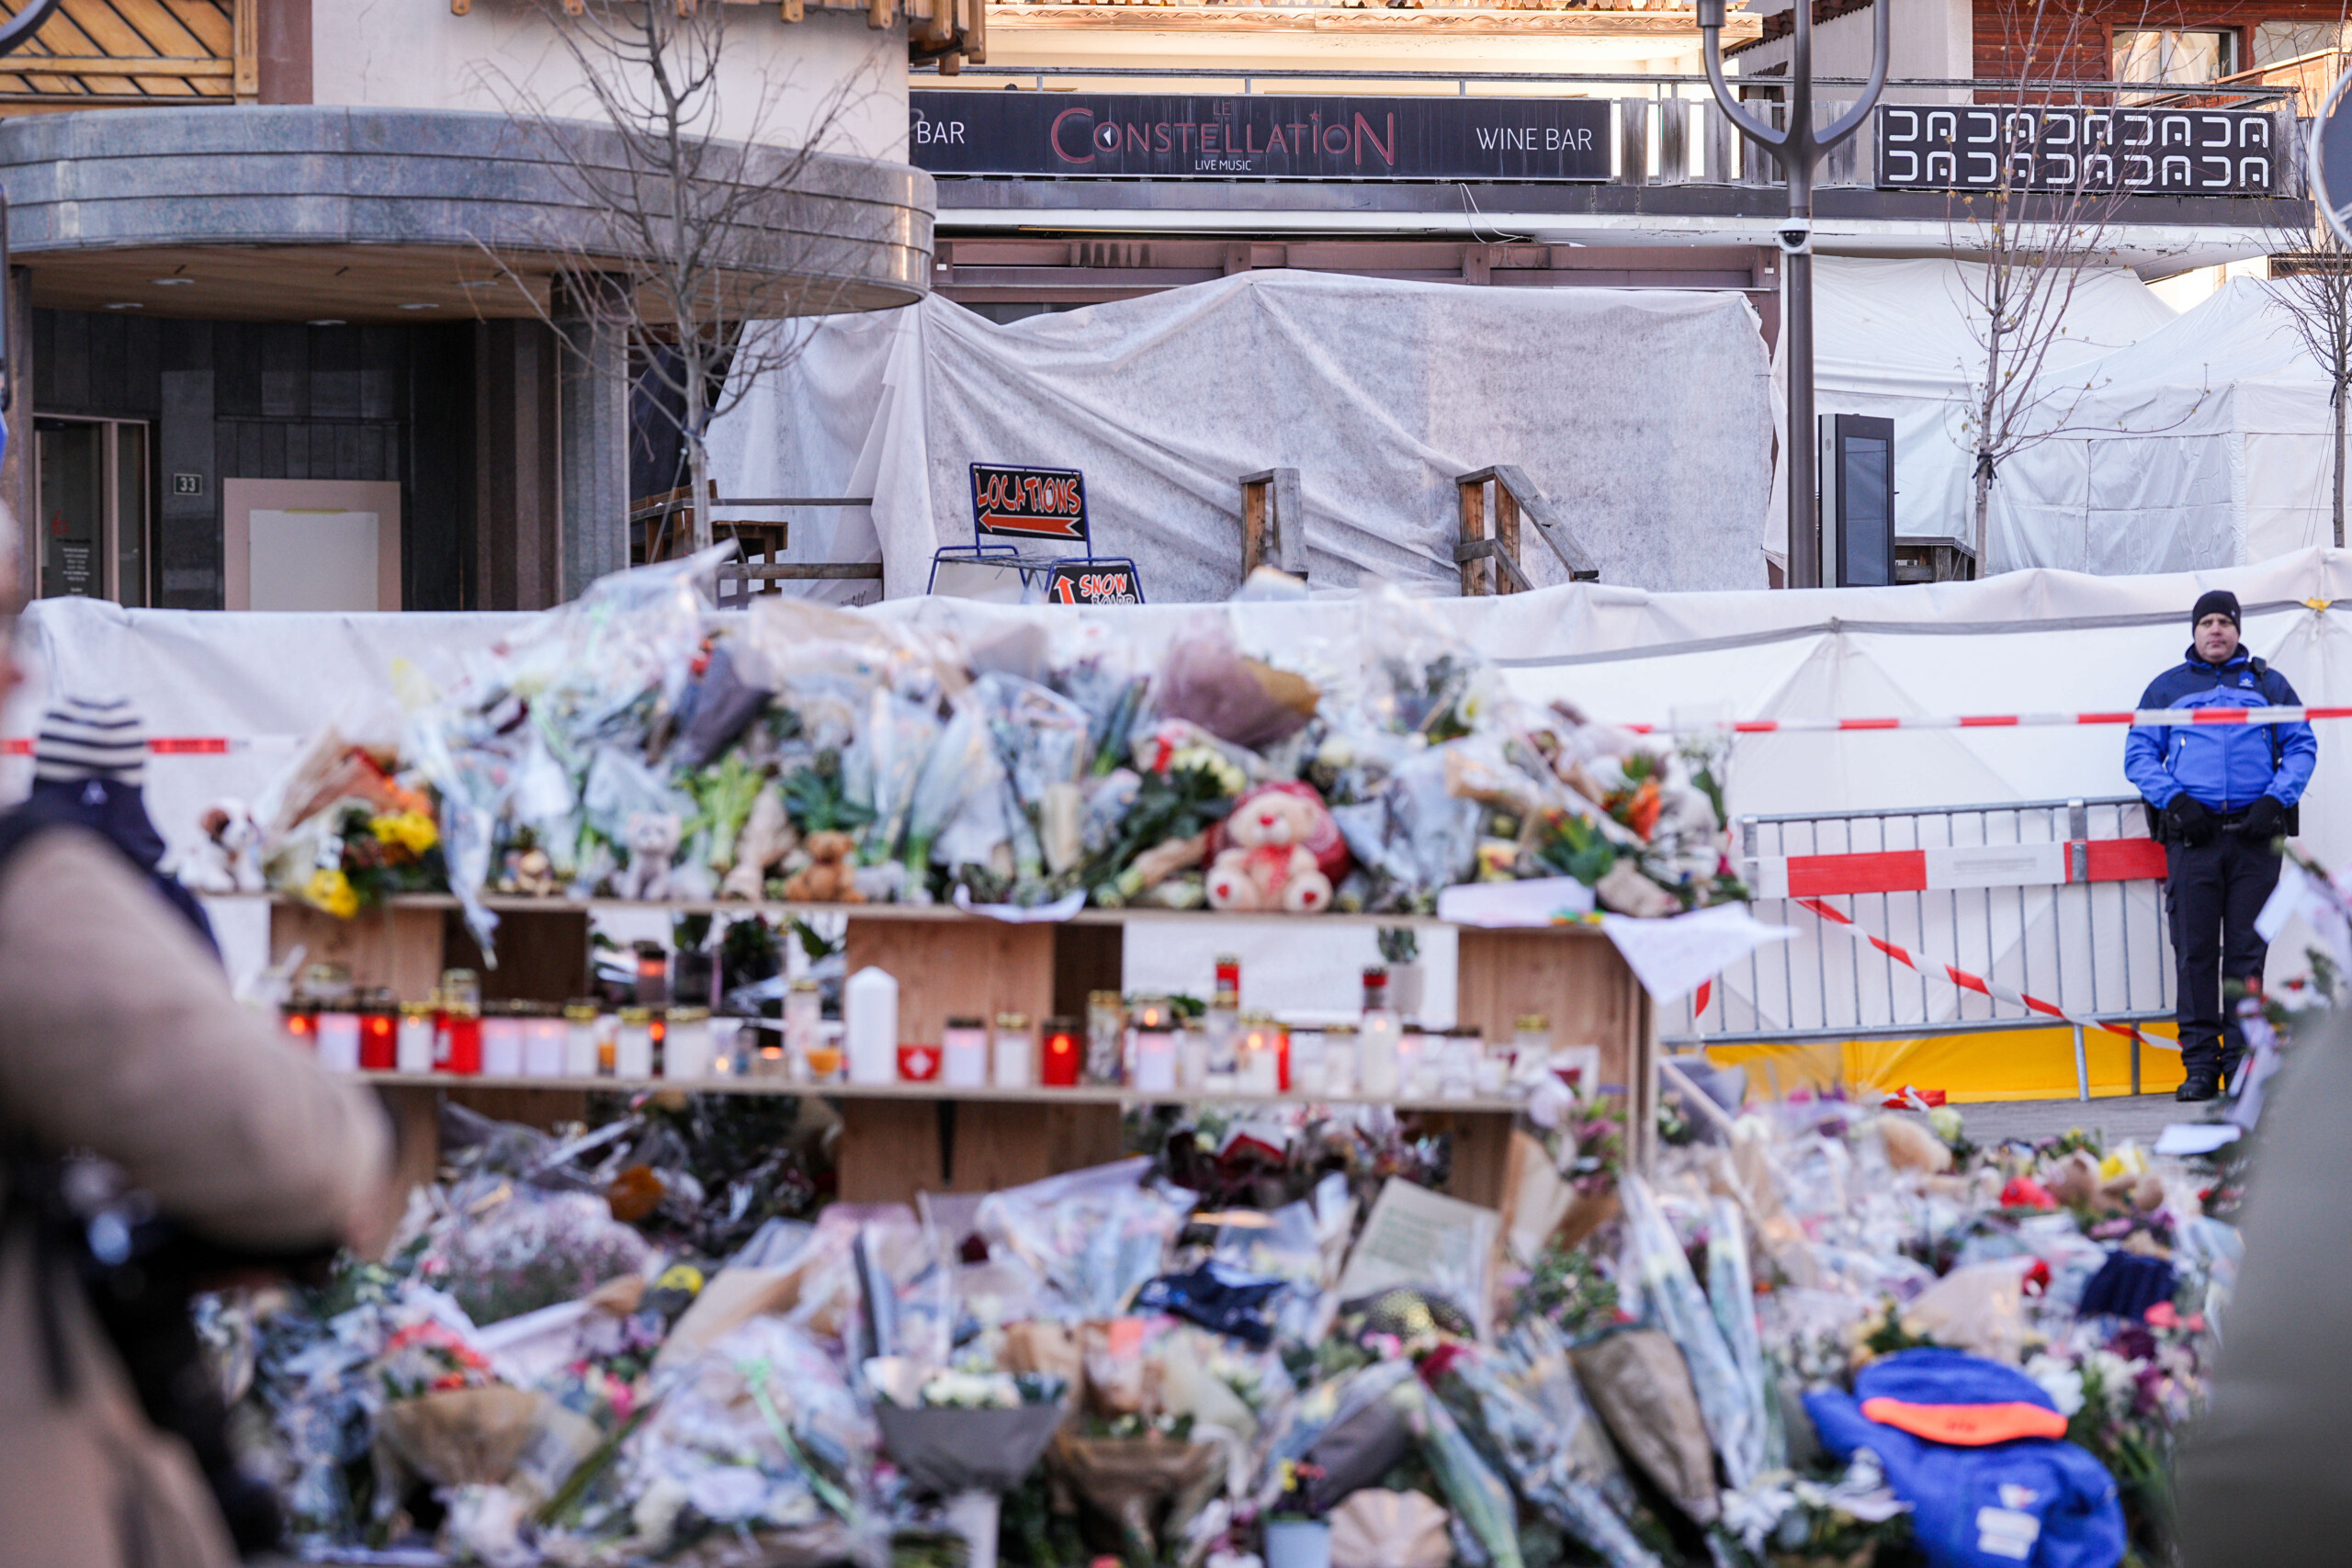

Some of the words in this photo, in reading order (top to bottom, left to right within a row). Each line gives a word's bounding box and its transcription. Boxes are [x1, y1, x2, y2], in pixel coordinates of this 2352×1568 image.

[917, 121, 965, 144] BAR
[1476, 127, 1538, 151] WINE
[1545, 128, 1592, 151] BAR
[1194, 159, 1216, 171] LIVE
[1218, 160, 1252, 171] MUSIC
[180, 477, 196, 491] 33
[976, 474, 1081, 514] LOCATIONS
[1079, 573, 1127, 597] SNOW
